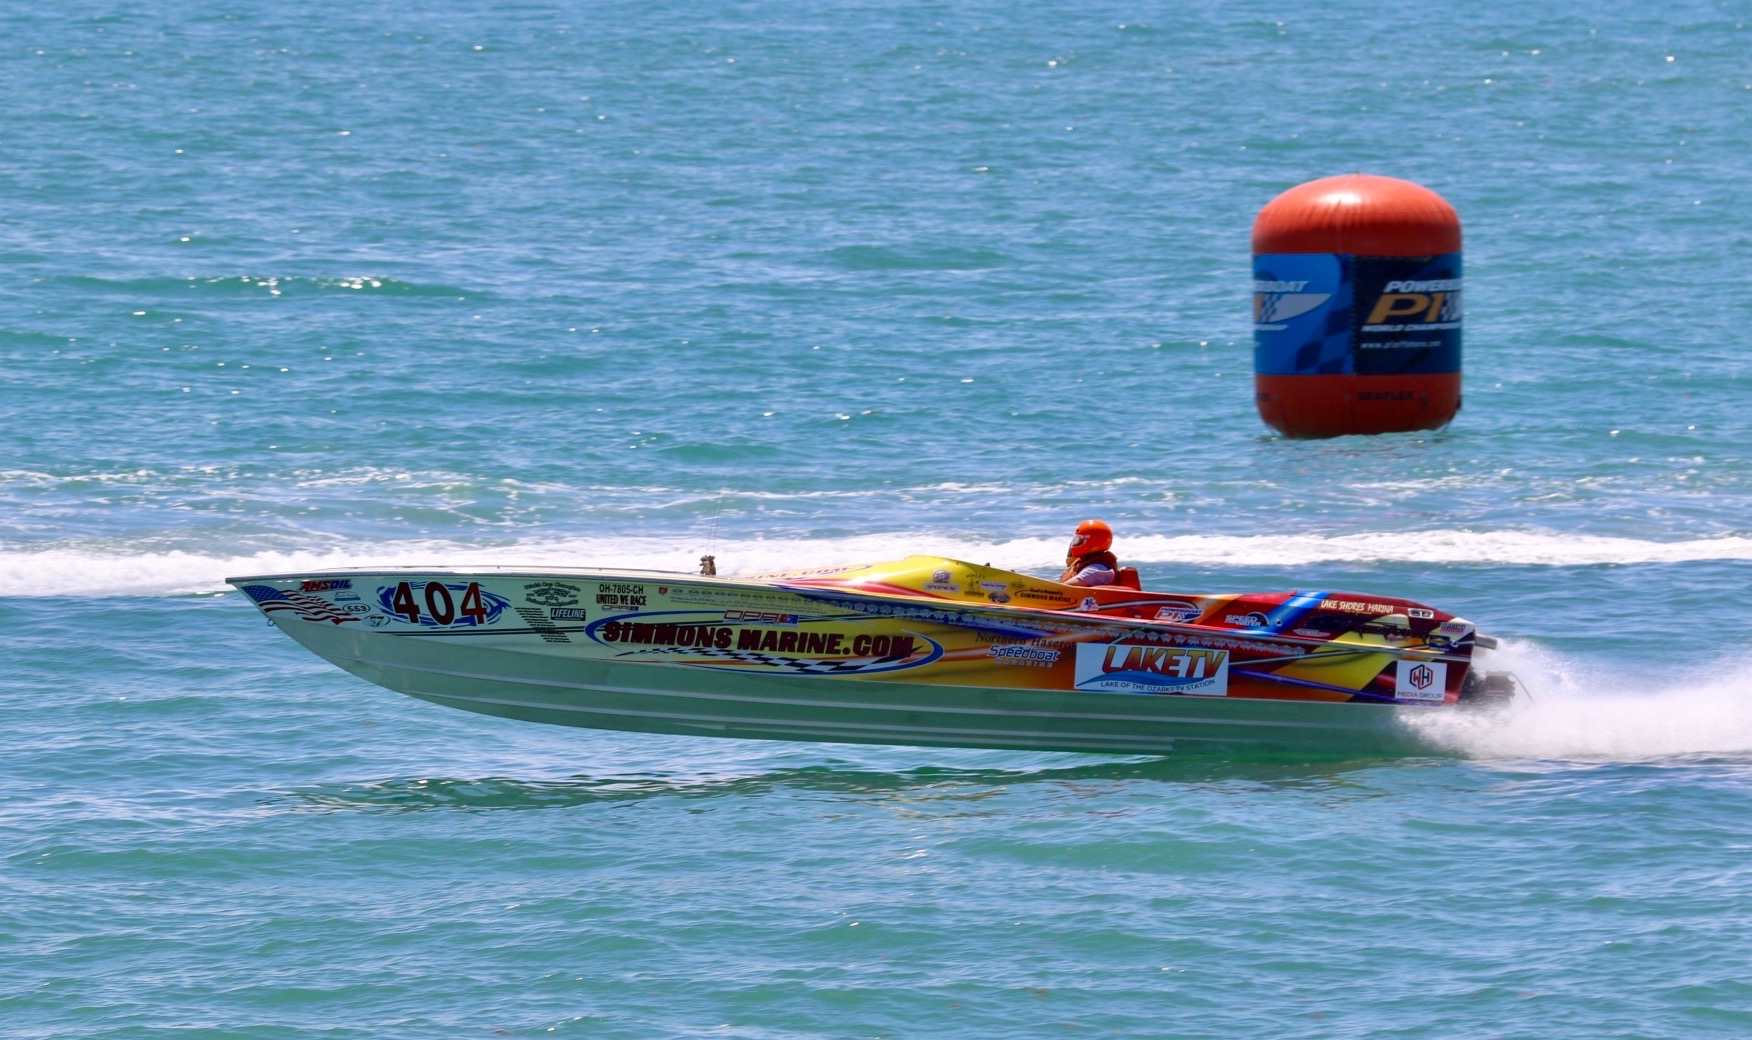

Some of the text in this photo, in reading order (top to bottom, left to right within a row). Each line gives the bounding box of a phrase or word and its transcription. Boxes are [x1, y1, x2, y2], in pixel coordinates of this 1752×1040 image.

[299, 579, 353, 592] AMSOIL
[599, 584, 644, 594] OH-7805-CH
[393, 581, 488, 625] 404
[596, 594, 647, 606] UNITED WE RACE
[1020, 592, 1048, 601] SIMMONS
[1049, 595, 1071, 603] MARINE
[1321, 600, 1338, 609] LAKE
[1339, 601, 1365, 611] SHORES
[1368, 603, 1394, 614] MARINA
[551, 609, 586, 619] LIFELINE
[724, 609, 779, 624] OPA
[1225, 614, 1258, 623] SPEED
[602, 620, 734, 649] SIMMONS
[736, 629, 916, 659] MARINE.COM
[976, 632, 1027, 645] Northern
[988, 645, 1060, 661] Speedboat
[995, 657, 1054, 667] MAGAZINE
[1186, 678, 1216, 691] STATION
